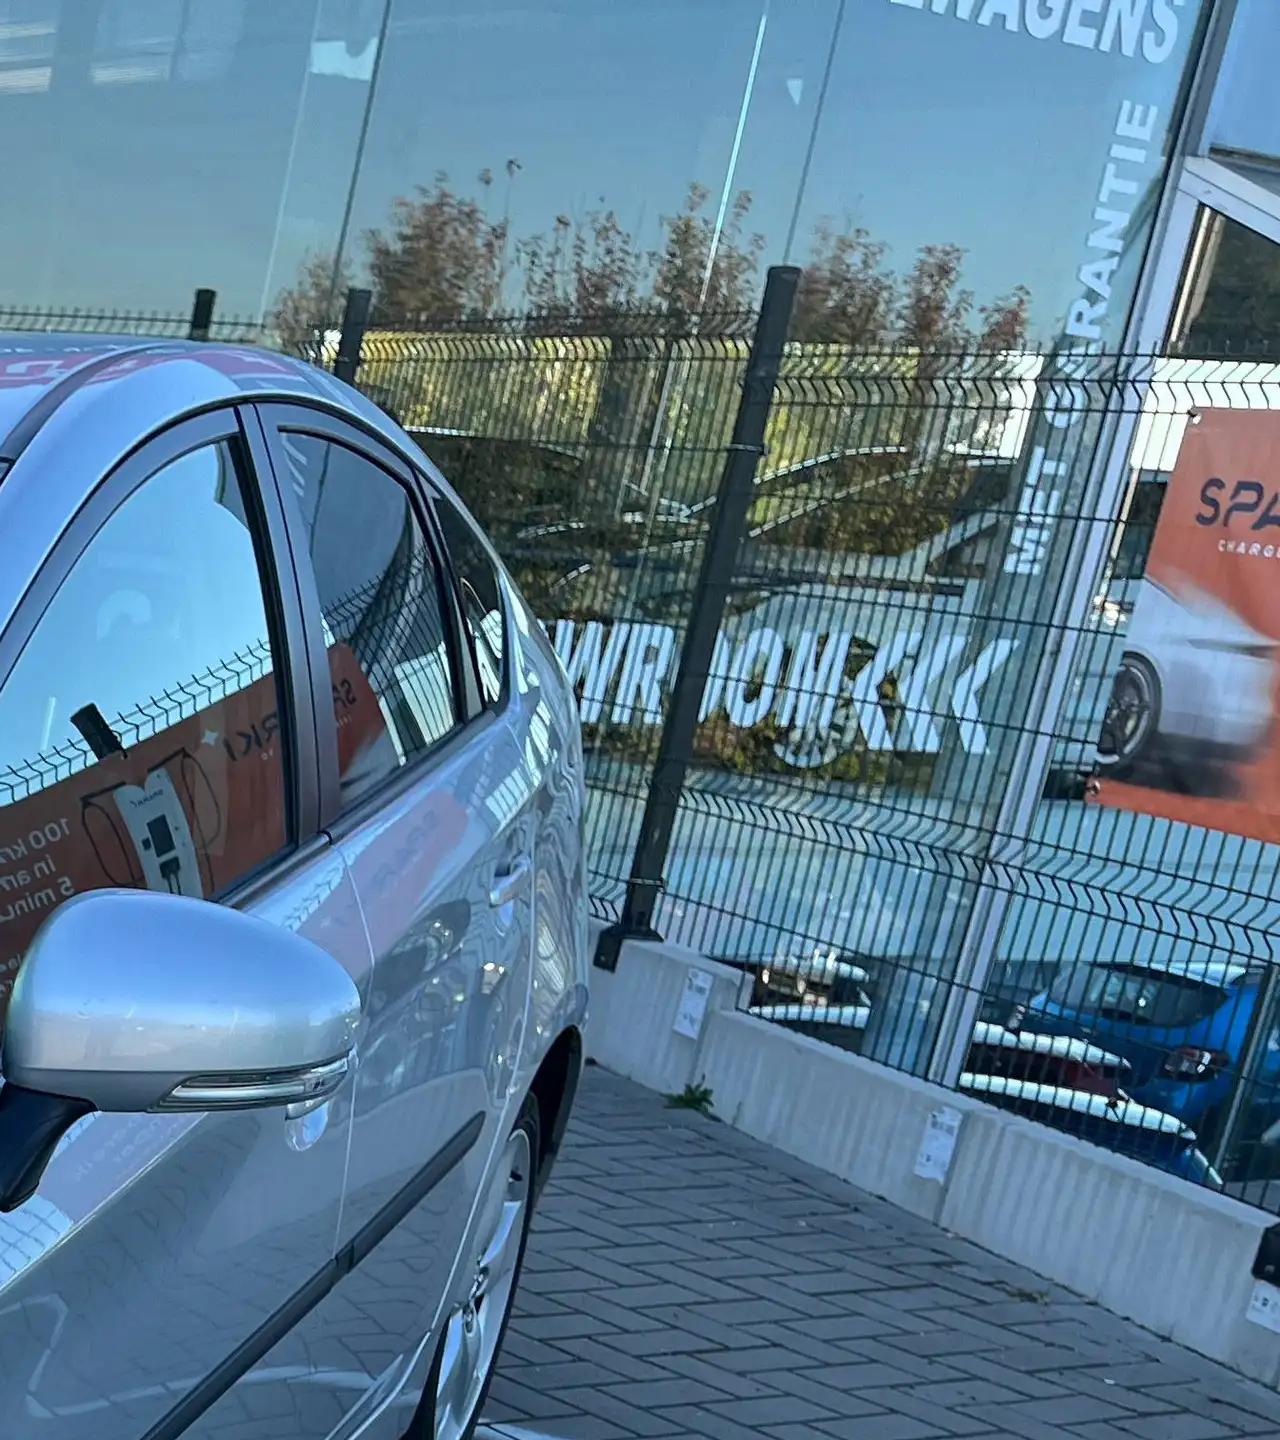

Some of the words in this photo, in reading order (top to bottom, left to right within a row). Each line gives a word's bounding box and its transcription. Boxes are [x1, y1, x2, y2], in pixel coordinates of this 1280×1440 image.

[1004, 445, 1068, 576] MET
[1044, 100, 1158, 428] GARANTIE
[1218, 539, 1280, 558] CHARG
